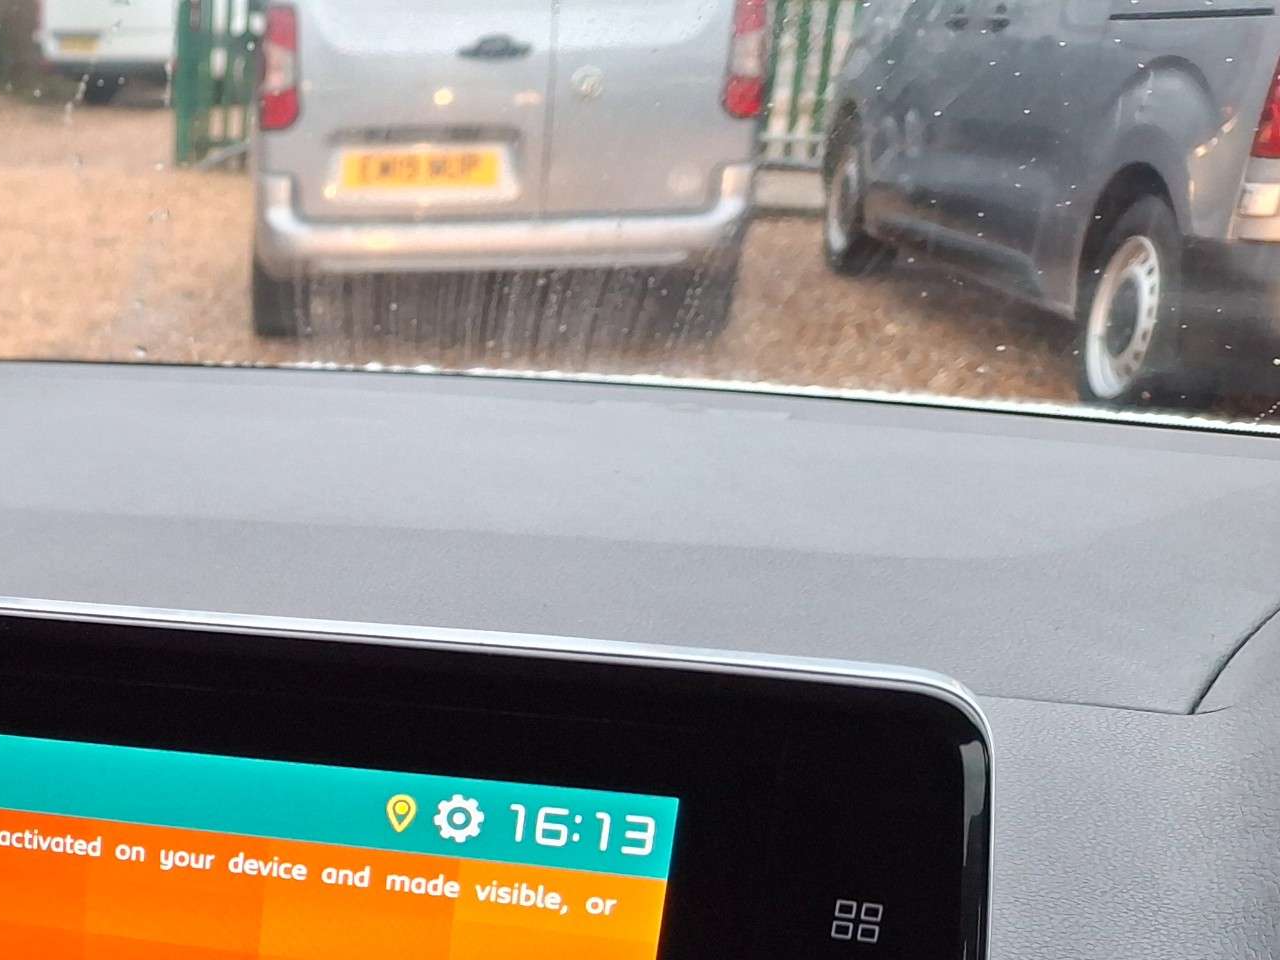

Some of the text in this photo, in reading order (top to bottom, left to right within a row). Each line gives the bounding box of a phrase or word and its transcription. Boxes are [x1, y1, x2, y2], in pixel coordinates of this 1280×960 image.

[510, 803, 656, 855] 16:13
[115, 843, 145, 862] on
[160, 848, 214, 871] your
[229, 853, 307, 881] device
[321, 867, 370, 888] and
[386, 873, 460, 897] made
[476, 881, 568, 915] visible,
[586, 895, 617, 915] or
